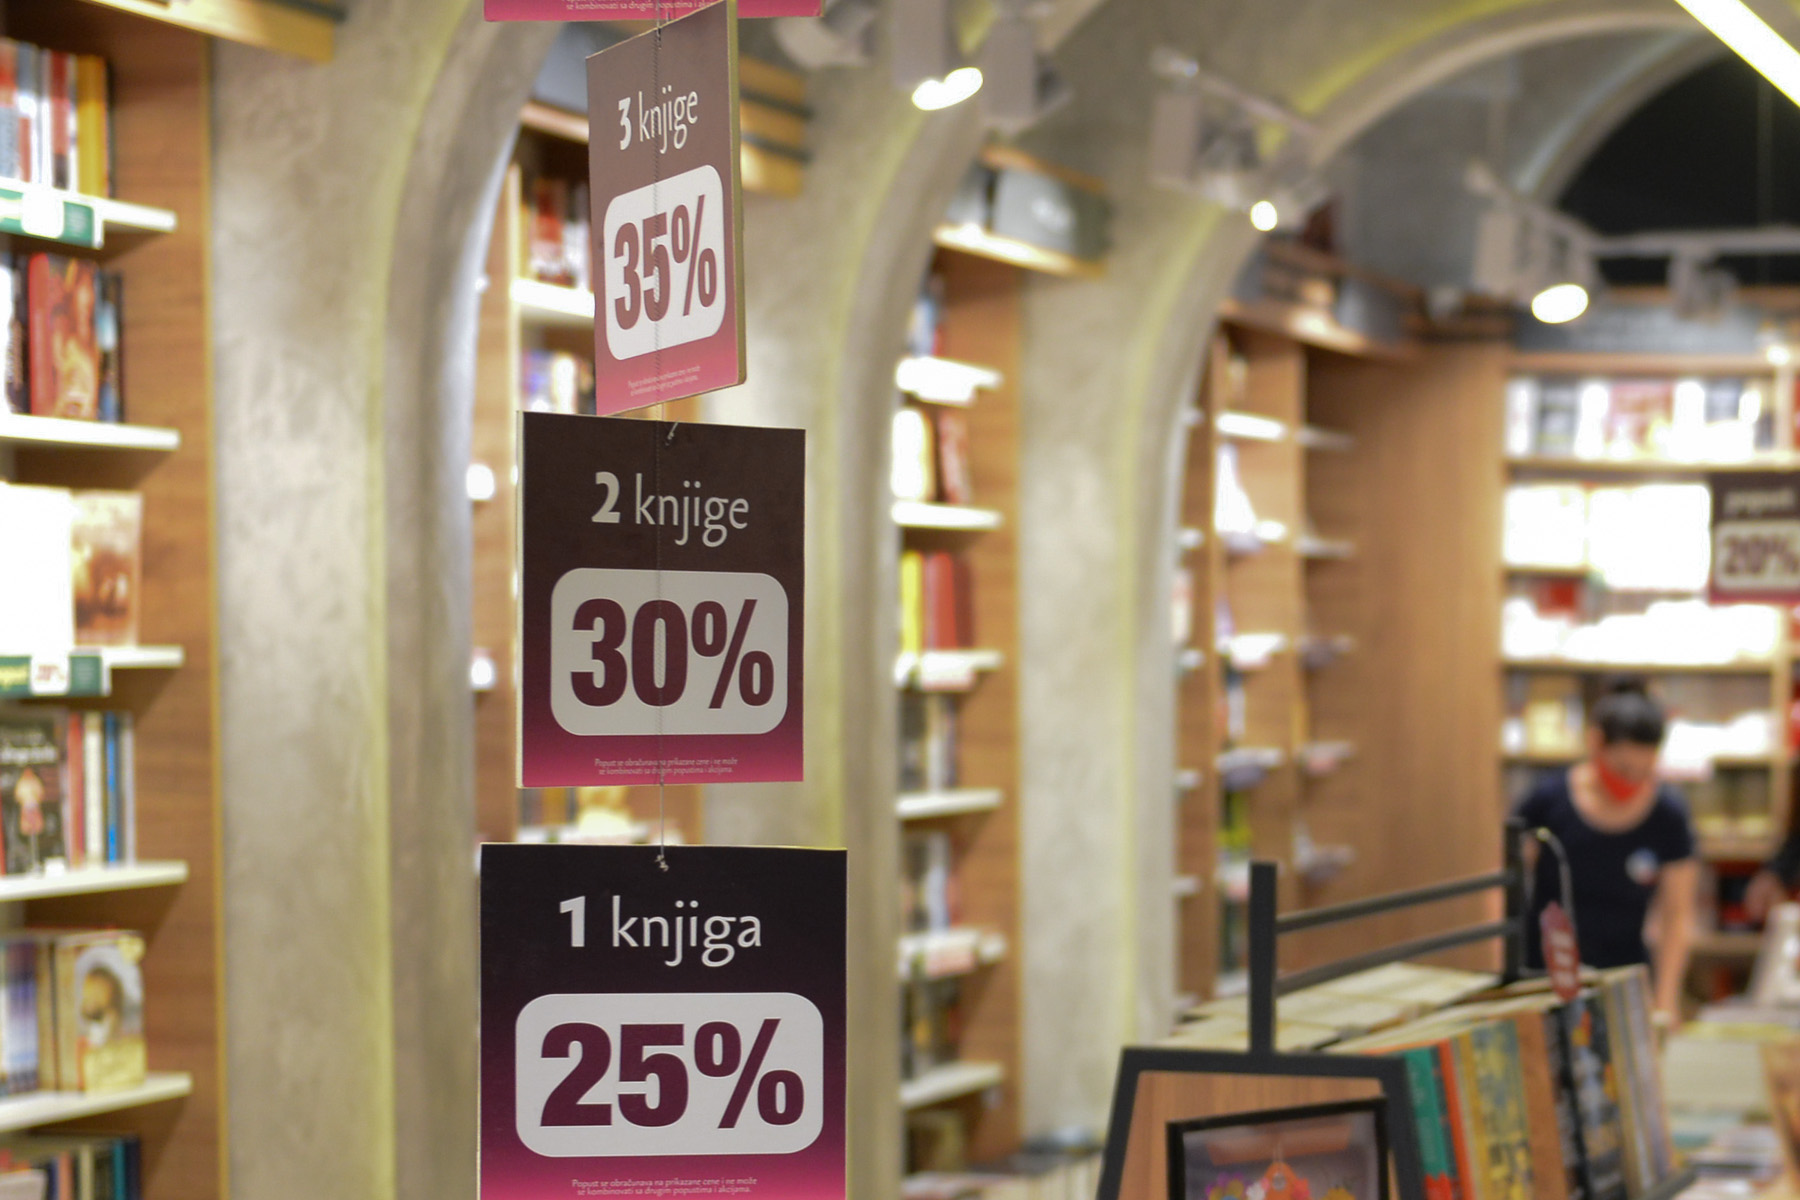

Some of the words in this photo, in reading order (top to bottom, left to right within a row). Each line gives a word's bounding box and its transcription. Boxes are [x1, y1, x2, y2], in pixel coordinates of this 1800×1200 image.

[618, 97, 632, 151] 3
[638, 84, 699, 155] knjige
[613, 194, 717, 331] 35%
[591, 471, 621, 523] 2
[635, 472, 750, 548] knjige
[570, 597, 775, 710] 30%
[559, 895, 586, 947] 1
[612, 895, 762, 967] knjiga
[540, 1018, 805, 1129] 25%
[572, 1179, 599, 1189] Popust
[665, 1178, 702, 1188] prikazane
[587, 1187, 634, 1196] kombinovati
[645, 1187, 672, 1197] drugim
[673, 1186, 712, 1196] popustima
